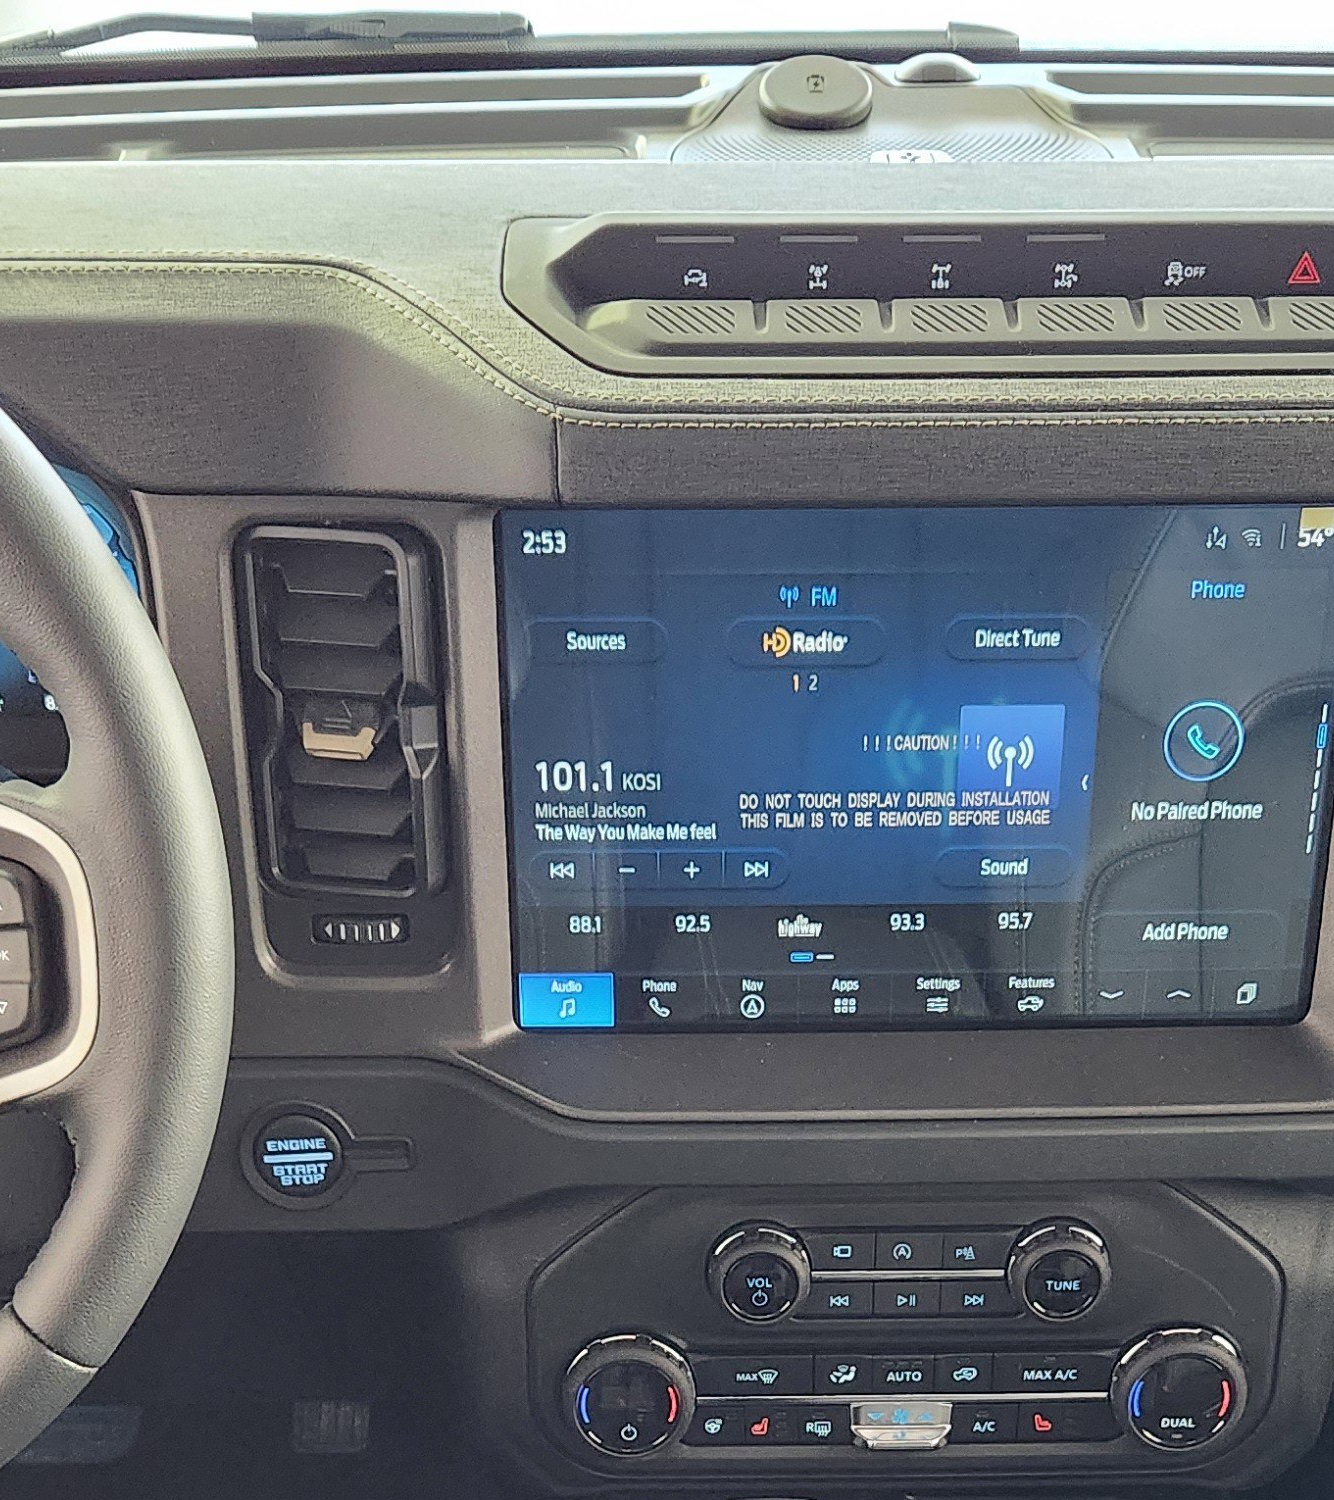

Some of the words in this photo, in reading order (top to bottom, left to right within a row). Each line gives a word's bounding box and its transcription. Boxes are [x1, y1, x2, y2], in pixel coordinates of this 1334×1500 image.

[1184, 266, 1207, 278] OFF
[522, 530, 567, 554] 2:53
[811, 588, 837, 607] FM
[1190, 579, 1245, 600] Phone
[567, 631, 627, 651] Sources
[975, 629, 1020, 648] Direct
[1022, 628, 1061, 648] Tune
[792, 674, 799, 691] 1
[808, 674, 818, 691] 2
[535, 761, 613, 793] 101.1
[622, 773, 661, 791] KOSI
[740, 794, 759, 810] DO
[765, 794, 791, 810] NOT
[797, 793, 841, 809] TOUCH
[847, 793, 900, 809] DISPLAY
[906, 792, 956, 808] DURING
[961, 790, 1050, 808] INSTALLATION
[535, 801, 590, 819] Michael
[591, 801, 647, 819] Jackson
[740, 812, 769, 829] THIS
[774, 812, 805, 828] FILM
[810, 812, 825, 828] IS
[830, 811, 849, 828] TO
[854, 811, 873, 828] BE
[878, 810, 942, 827] REMOVED
[948, 809, 1000, 826] BEFORE
[1005, 808, 1051, 826] USAGE
[1131, 803, 1154, 821] No
[1156, 801, 1210, 821] Paired
[1213, 800, 1263, 821] Phone
[535, 823, 563, 842] The
[564, 823, 596, 843] Way
[596, 823, 626, 841] You
[627, 823, 666, 841] Make
[667, 823, 689, 841] Me
[690, 822, 717, 841] feel
[980, 857, 1029, 877] Sound
[569, 915, 602, 934] 88.1
[675, 914, 711, 934] 92.5
[890, 913, 925, 931] 93.3
[997, 912, 1034, 931] 95.7
[1142, 923, 1175, 942] Add
[1177, 922, 1229, 942] Phone
[551, 979, 583, 995] Audio
[642, 979, 677, 994] Phone
[742, 979, 764, 993] Nav
[831, 978, 859, 995] Apps
[916, 976, 961, 994] Settings
[1008, 975, 1055, 991] Features
[266, 1138, 326, 1151] ENGINE
[273, 1163, 328, 1176] START
[281, 1174, 325, 1186] STOP
[746, 1278, 772, 1288] VOL
[1045, 1279, 1081, 1291] TUNE
[736, 1372, 758, 1382] MAX
[886, 1369, 922, 1382] AUTO
[1023, 1369, 1052, 1382] MAX
[1054, 1368, 1078, 1381] A/C
[973, 1420, 996, 1433] A/C
[1161, 1417, 1195, 1429] DUAL
